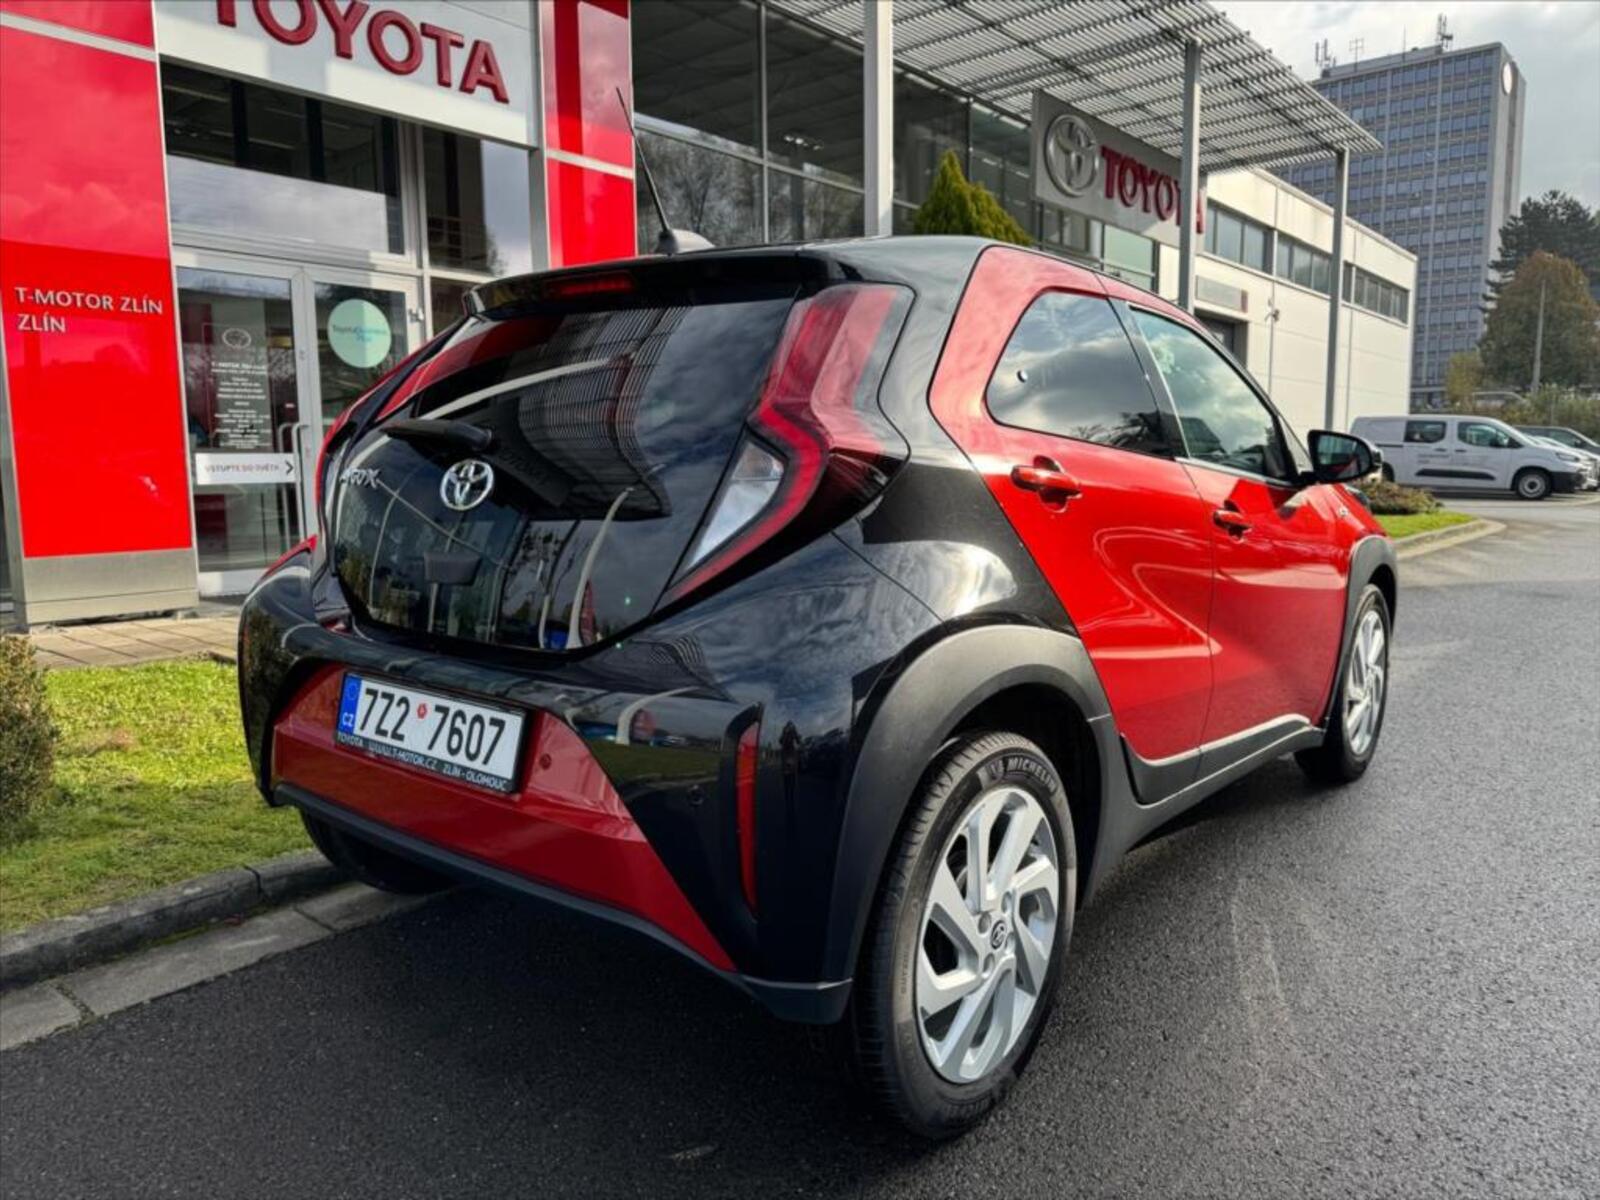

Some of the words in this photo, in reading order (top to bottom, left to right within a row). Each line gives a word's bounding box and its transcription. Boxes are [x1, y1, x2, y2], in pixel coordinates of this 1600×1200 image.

[15, 287, 113, 310] T-MOTOR
[120, 294, 163, 315] ZLÍN
[18, 311, 66, 333] ZLÍN
[342, 712, 354, 727] CZ
[360, 688, 410, 742] 7Z2
[428, 704, 506, 765] 7607
[1008, 757, 1058, 795] MICHELIN
